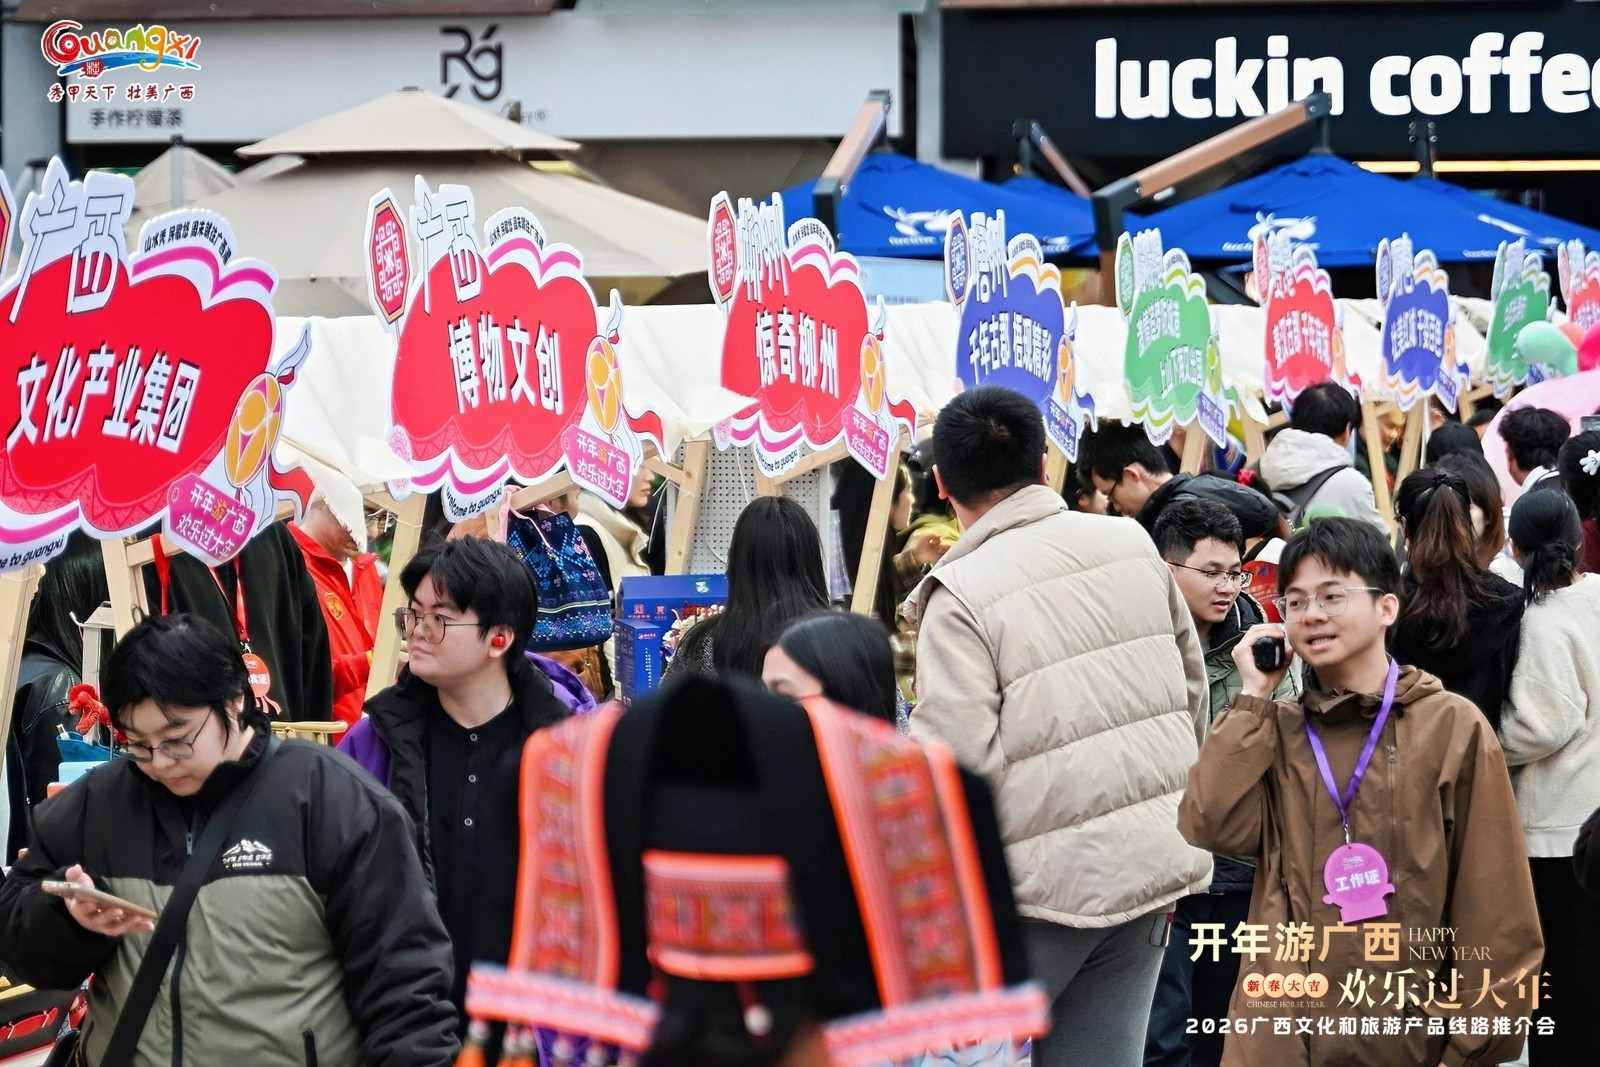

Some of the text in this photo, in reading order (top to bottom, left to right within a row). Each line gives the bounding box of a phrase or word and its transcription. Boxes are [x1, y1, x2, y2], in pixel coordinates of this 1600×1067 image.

[1095, 32, 1600, 119] luckin coffe
[9, 178, 124, 326] 广西
[417, 192, 481, 316] 广西
[448, 312, 562, 415] 博物文创
[755, 305, 839, 399] 惊奇柳州
[6, 340, 200, 454] 文化产业集团
[576, 459, 625, 499] 欢乐过大年
[577, 433, 626, 475] 开年游广西
[190, 483, 247, 535] 开年游广西
[468, 501, 477, 514] to
[9, 553, 22, 567] to
[20, 534, 64, 566] guangxi
[176, 512, 234, 559] 欢乐过大年
[1334, 869, 1380, 892] 工作证
